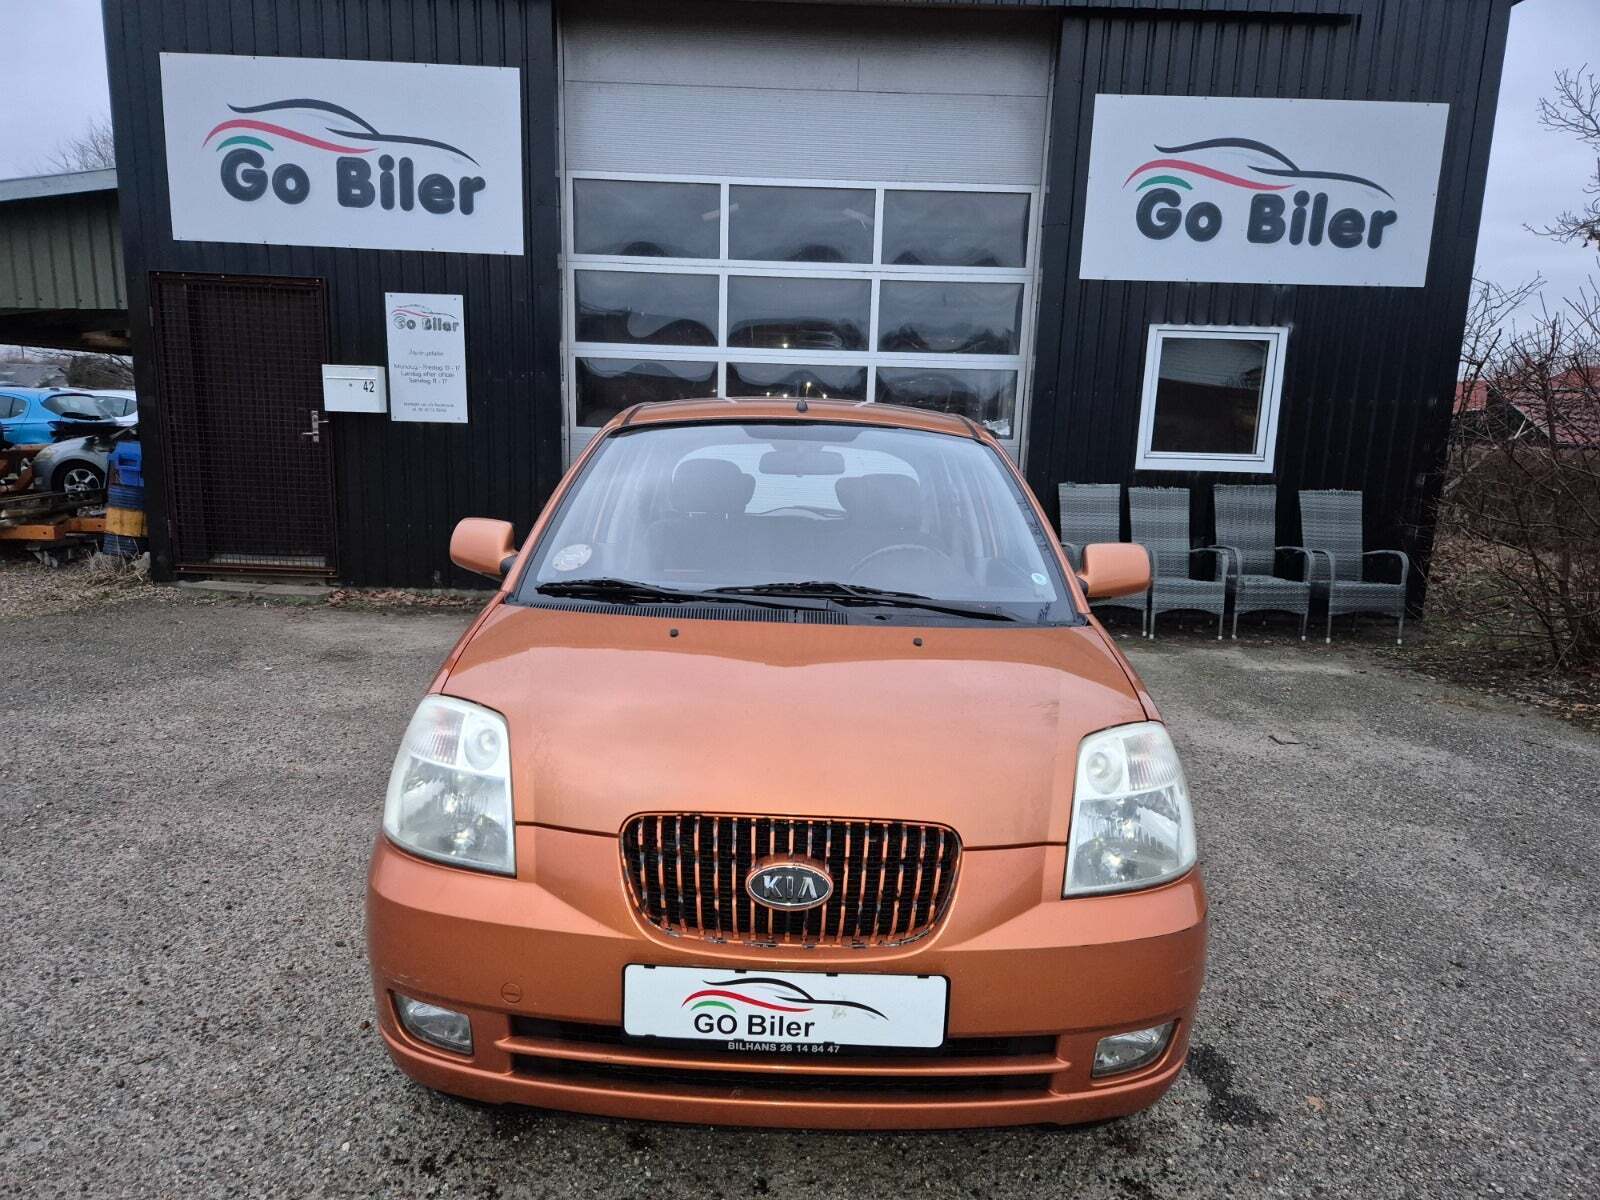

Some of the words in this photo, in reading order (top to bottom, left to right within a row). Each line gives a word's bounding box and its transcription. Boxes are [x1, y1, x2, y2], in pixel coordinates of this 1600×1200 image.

[220, 147, 311, 205] Go
[336, 154, 486, 216] Biler
[1136, 187, 1222, 242] Go
[1246, 190, 1398, 249] Biler
[363, 381, 375, 393] 42
[763, 875, 818, 899] KIA
[694, 1013, 738, 1035] GO
[747, 1014, 815, 1037] Biler
[727, 1042, 777, 1052] BILHANS
[796, 1045, 808, 1053] 14
[811, 1045, 824, 1053] 84
[827, 1045, 840, 1054] 47
